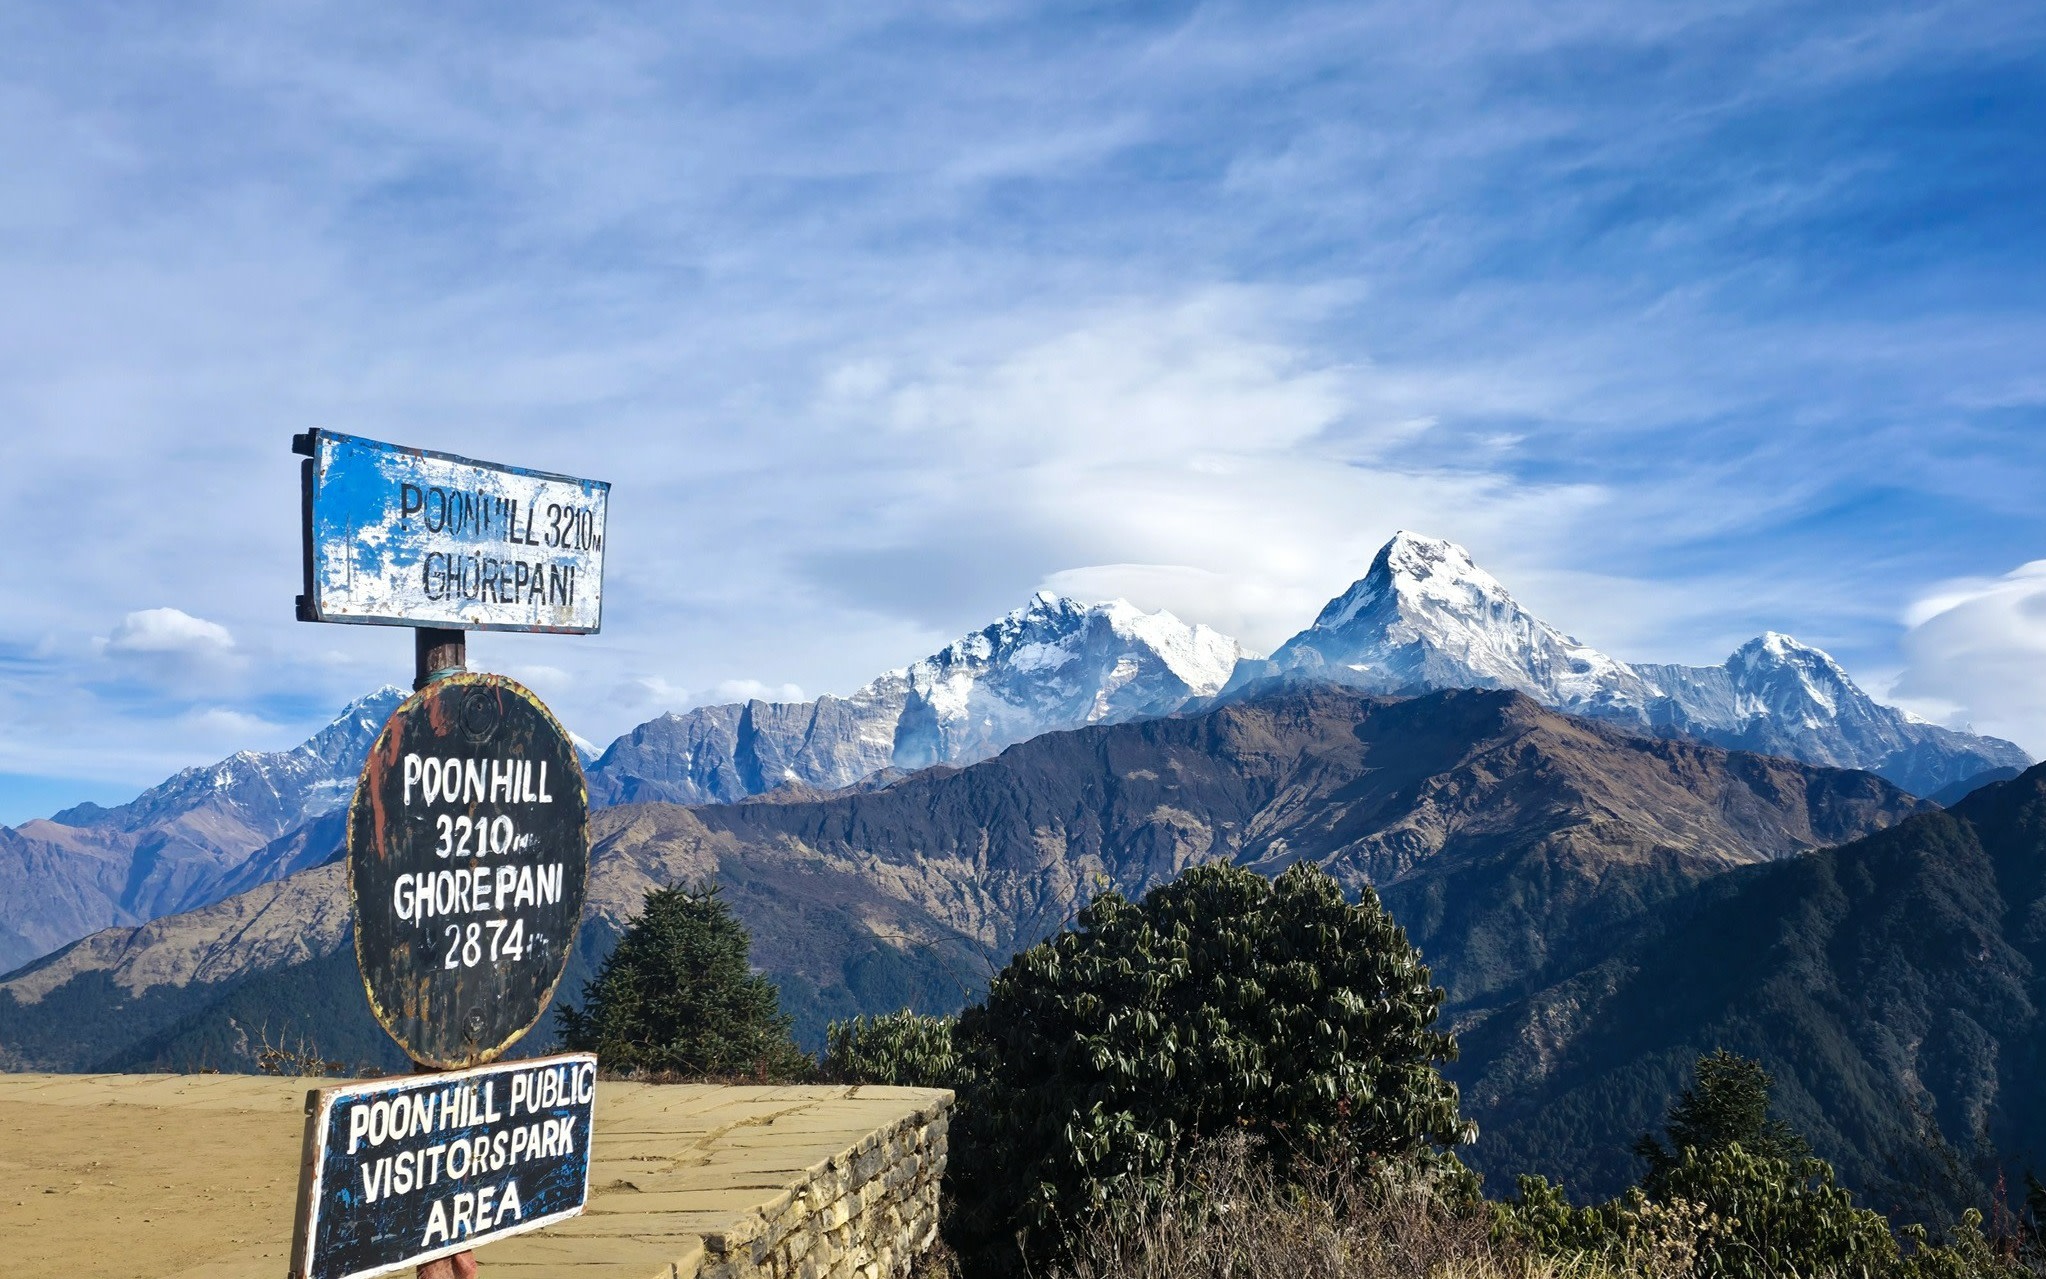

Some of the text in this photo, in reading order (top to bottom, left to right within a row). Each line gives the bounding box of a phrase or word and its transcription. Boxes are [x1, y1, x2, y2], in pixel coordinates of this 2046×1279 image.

[422, 551, 575, 606] GHOREPANI
[393, 862, 563, 928] GHOREPANI
[510, 1061, 594, 1117] PUBLIC
[421, 1181, 522, 1247] AREA
